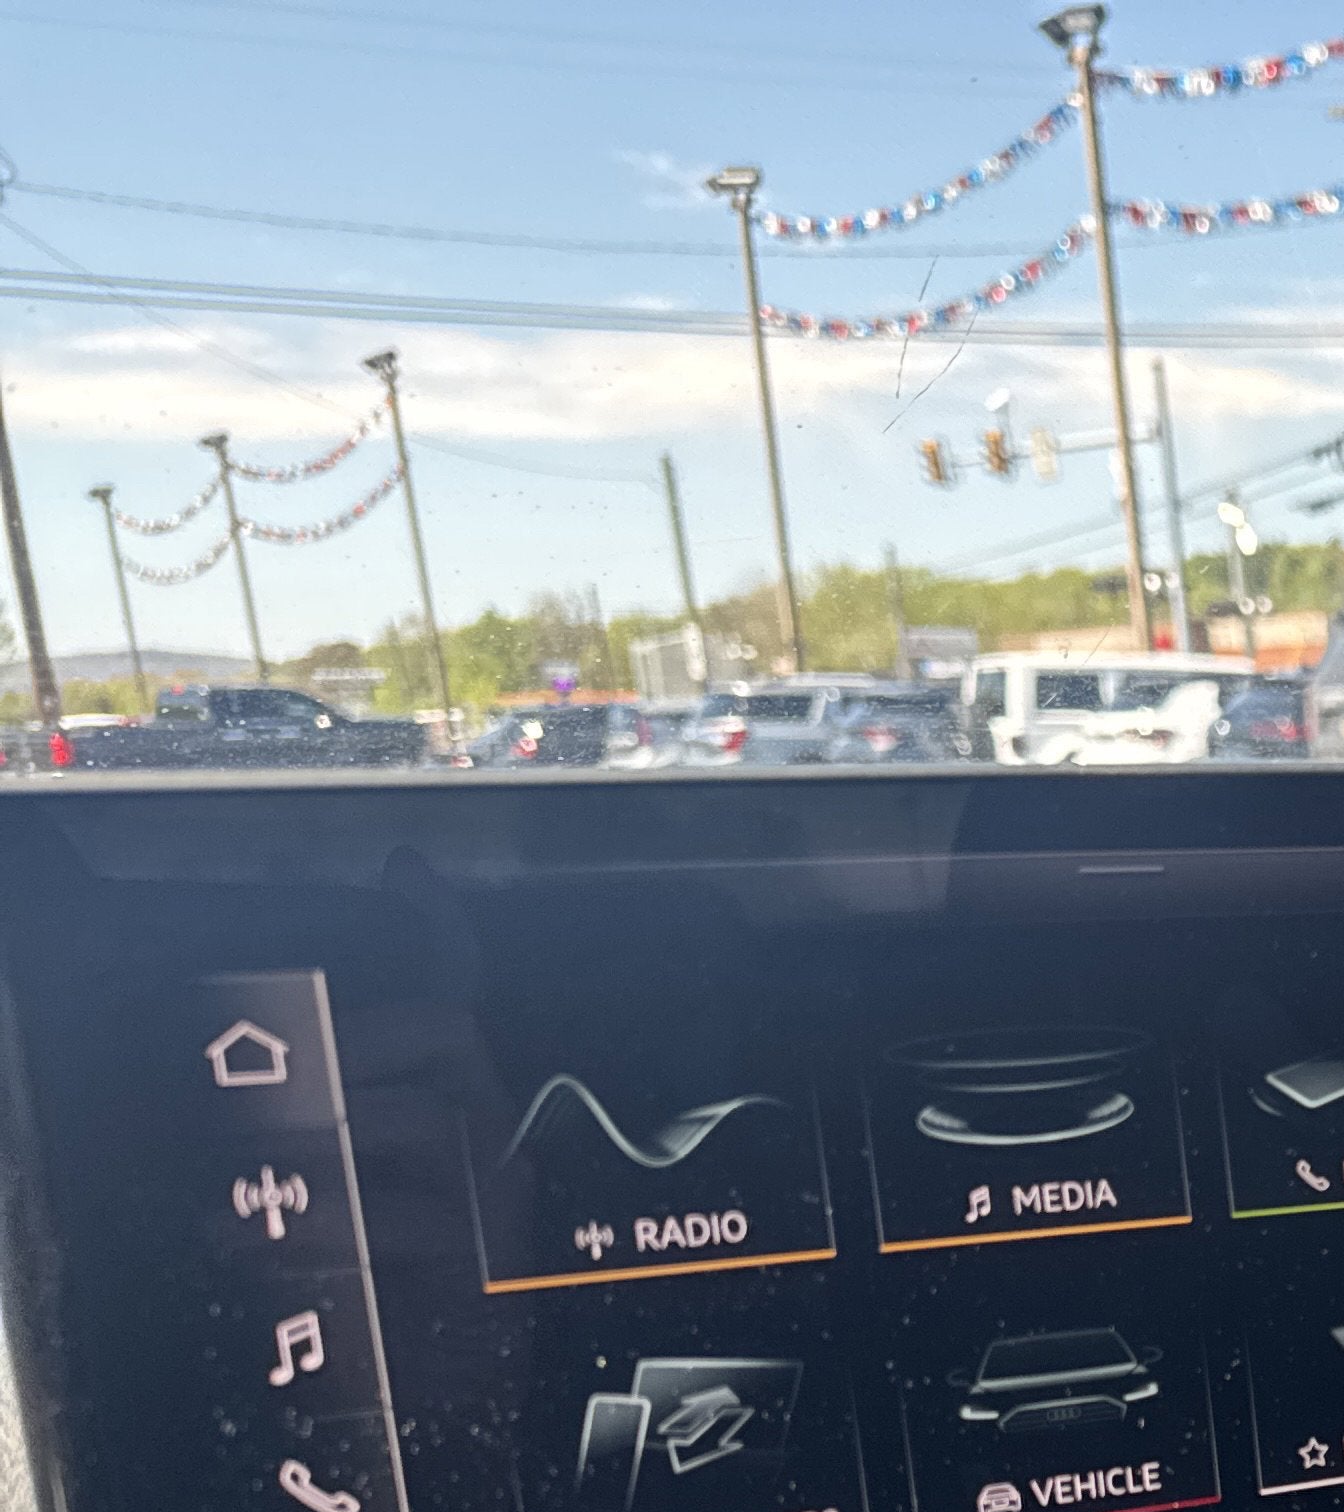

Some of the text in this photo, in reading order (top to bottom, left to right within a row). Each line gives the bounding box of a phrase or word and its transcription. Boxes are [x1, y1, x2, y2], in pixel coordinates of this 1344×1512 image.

[1010, 1179, 1119, 1217] MEDIA
[633, 1209, 749, 1254] RADIO
[1028, 1460, 1163, 1508] VEHICLE
